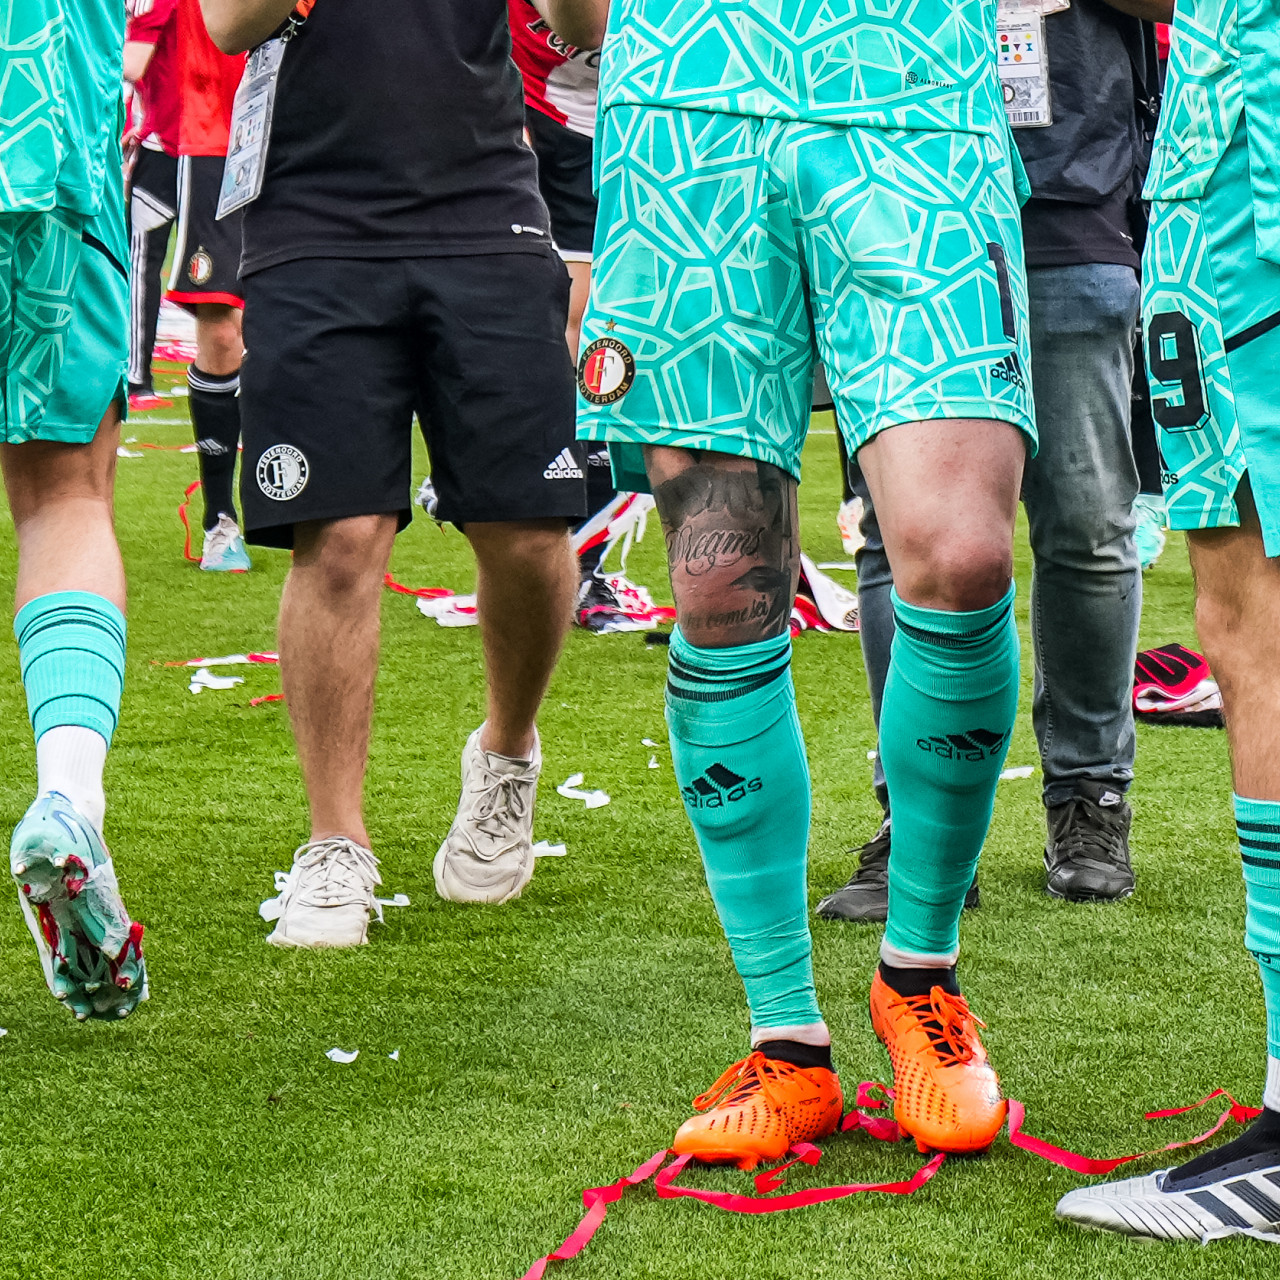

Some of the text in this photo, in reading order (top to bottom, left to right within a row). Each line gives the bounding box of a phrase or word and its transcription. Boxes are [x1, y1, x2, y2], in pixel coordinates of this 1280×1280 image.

[582, 340, 632, 364] FEYENOORD
[1148, 310, 1212, 434] 9
[578, 379, 629, 404] ROTTERDAM
[260, 447, 303, 468] FEYENOORD
[543, 468, 584, 480] adidas
[261, 476, 306, 498] ROTTERDAM
